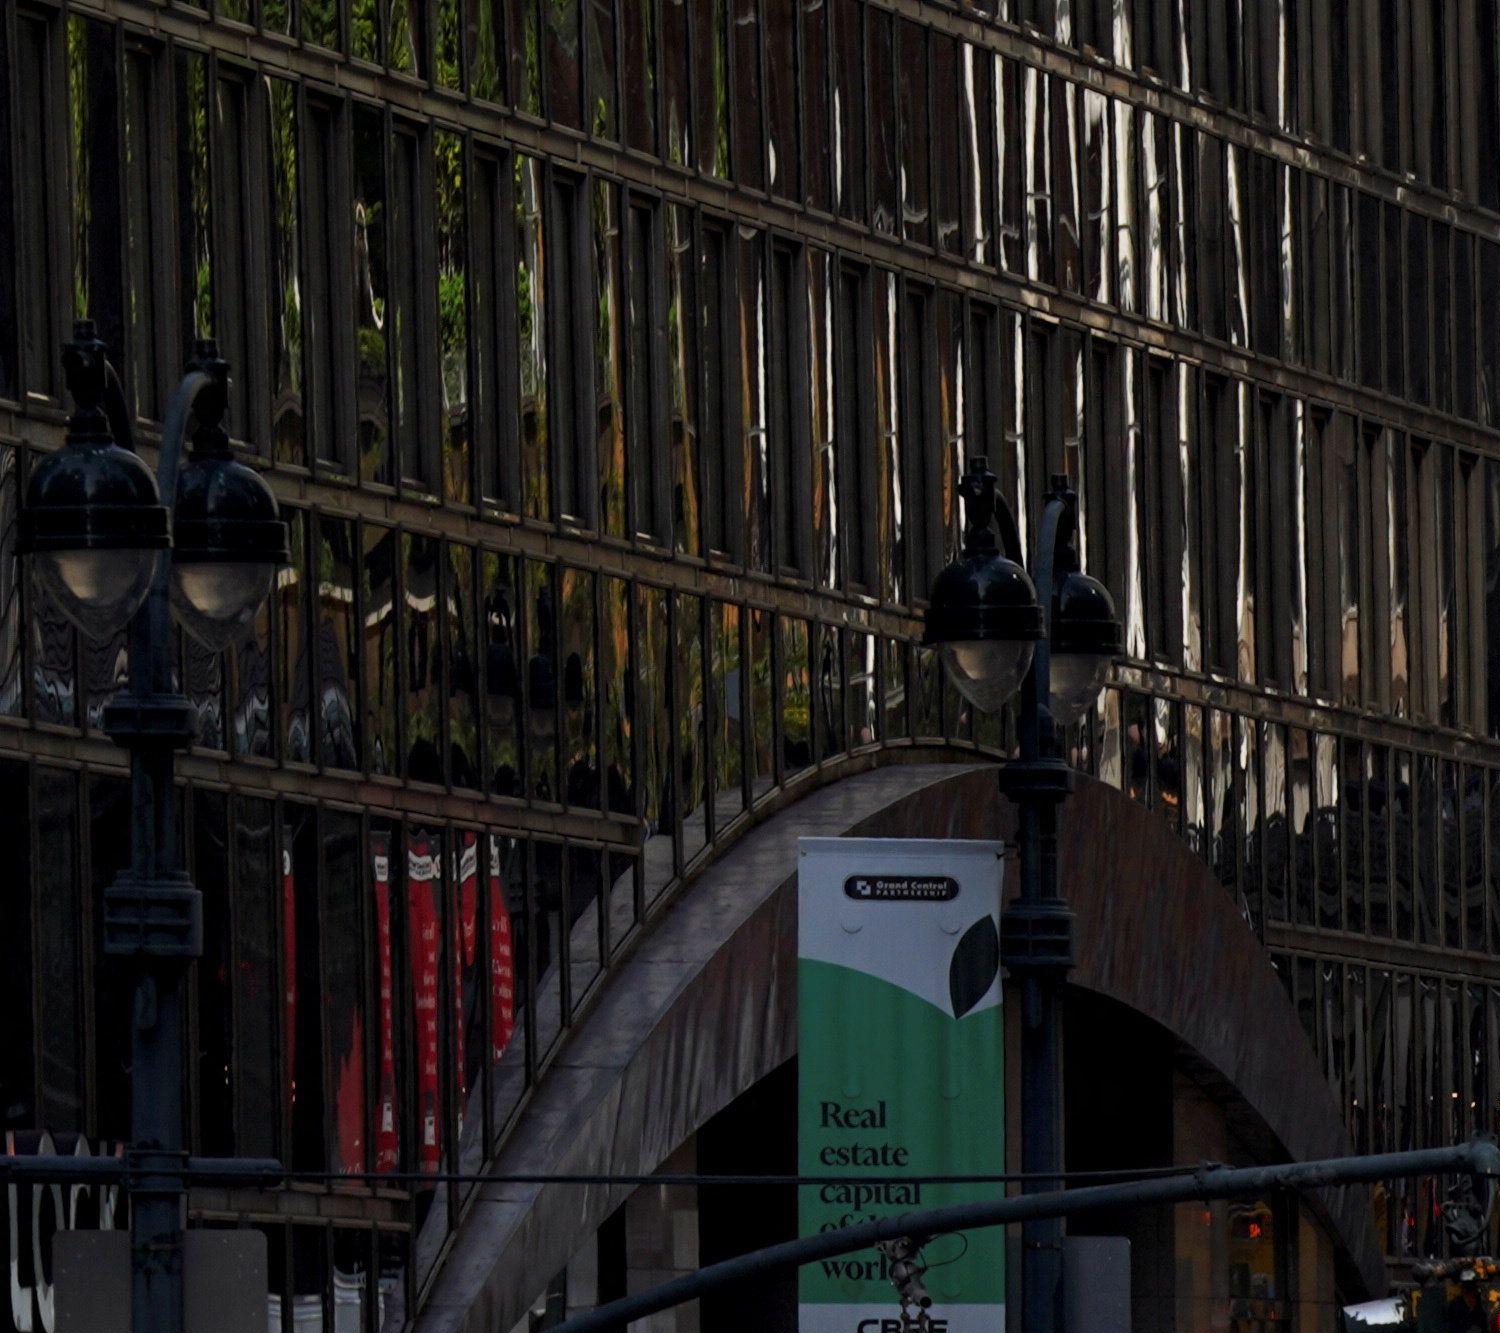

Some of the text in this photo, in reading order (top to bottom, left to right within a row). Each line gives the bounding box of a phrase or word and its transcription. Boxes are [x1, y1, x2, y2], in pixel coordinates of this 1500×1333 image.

[876, 879, 948, 889] Grand Central
[876, 889, 948, 897] PARTNERSHIP
[820, 1101, 887, 1130] Real
[820, 1143, 909, 1168] estate
[820, 1179, 922, 1211] capital
